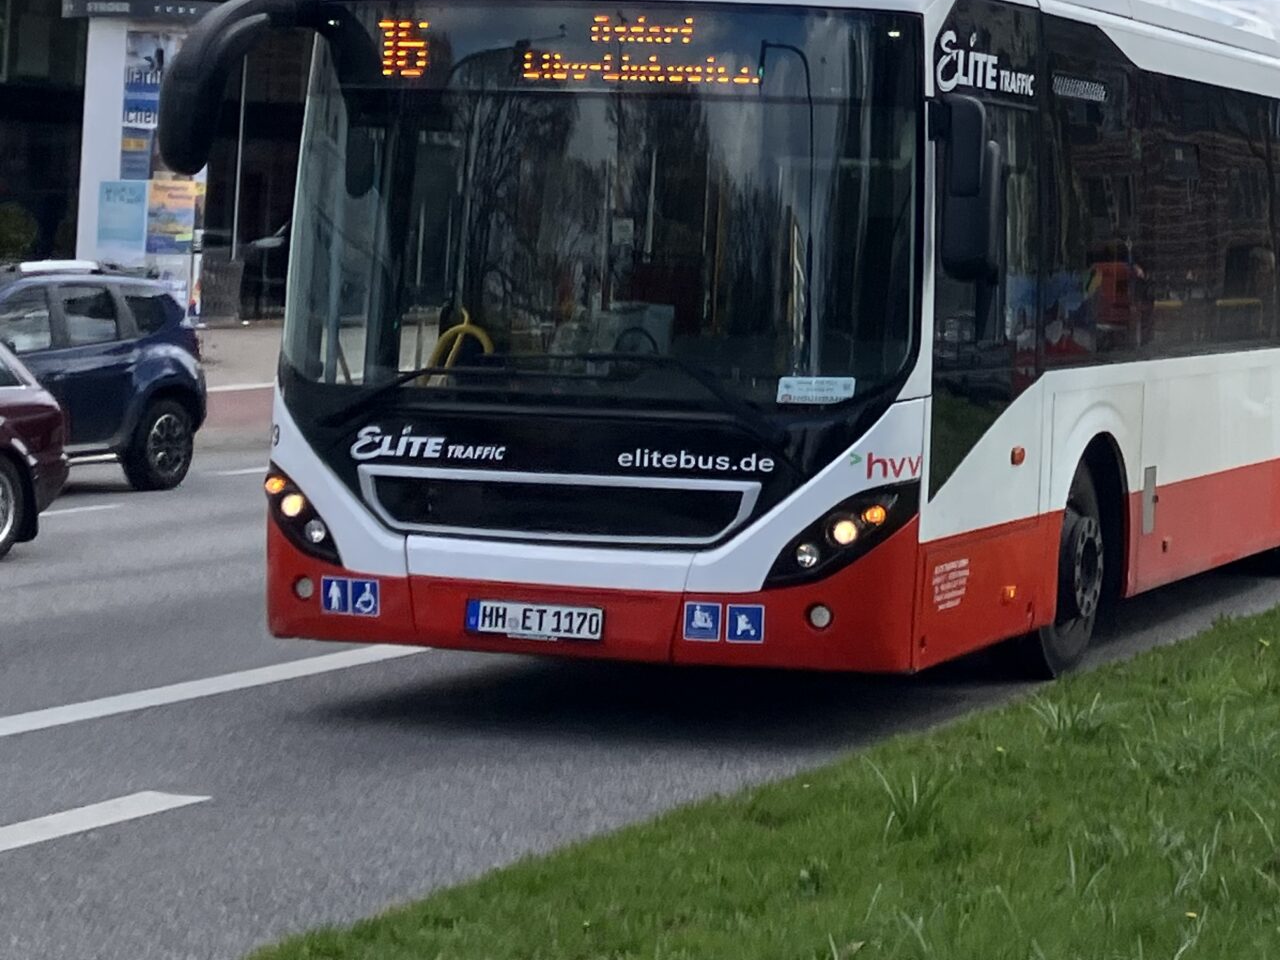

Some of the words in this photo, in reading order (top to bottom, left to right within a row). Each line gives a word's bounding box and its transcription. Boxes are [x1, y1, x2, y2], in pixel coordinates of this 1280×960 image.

[1000, 69, 1036, 97] TRAFFIC
[447, 445, 506, 461] TRAFFIC
[617, 448, 775, 473] elitebus.de
[866, 452, 922, 479] hvv
[481, 605, 508, 629] HH
[521, 608, 548, 632] ET
[551, 610, 600, 636] 1170
